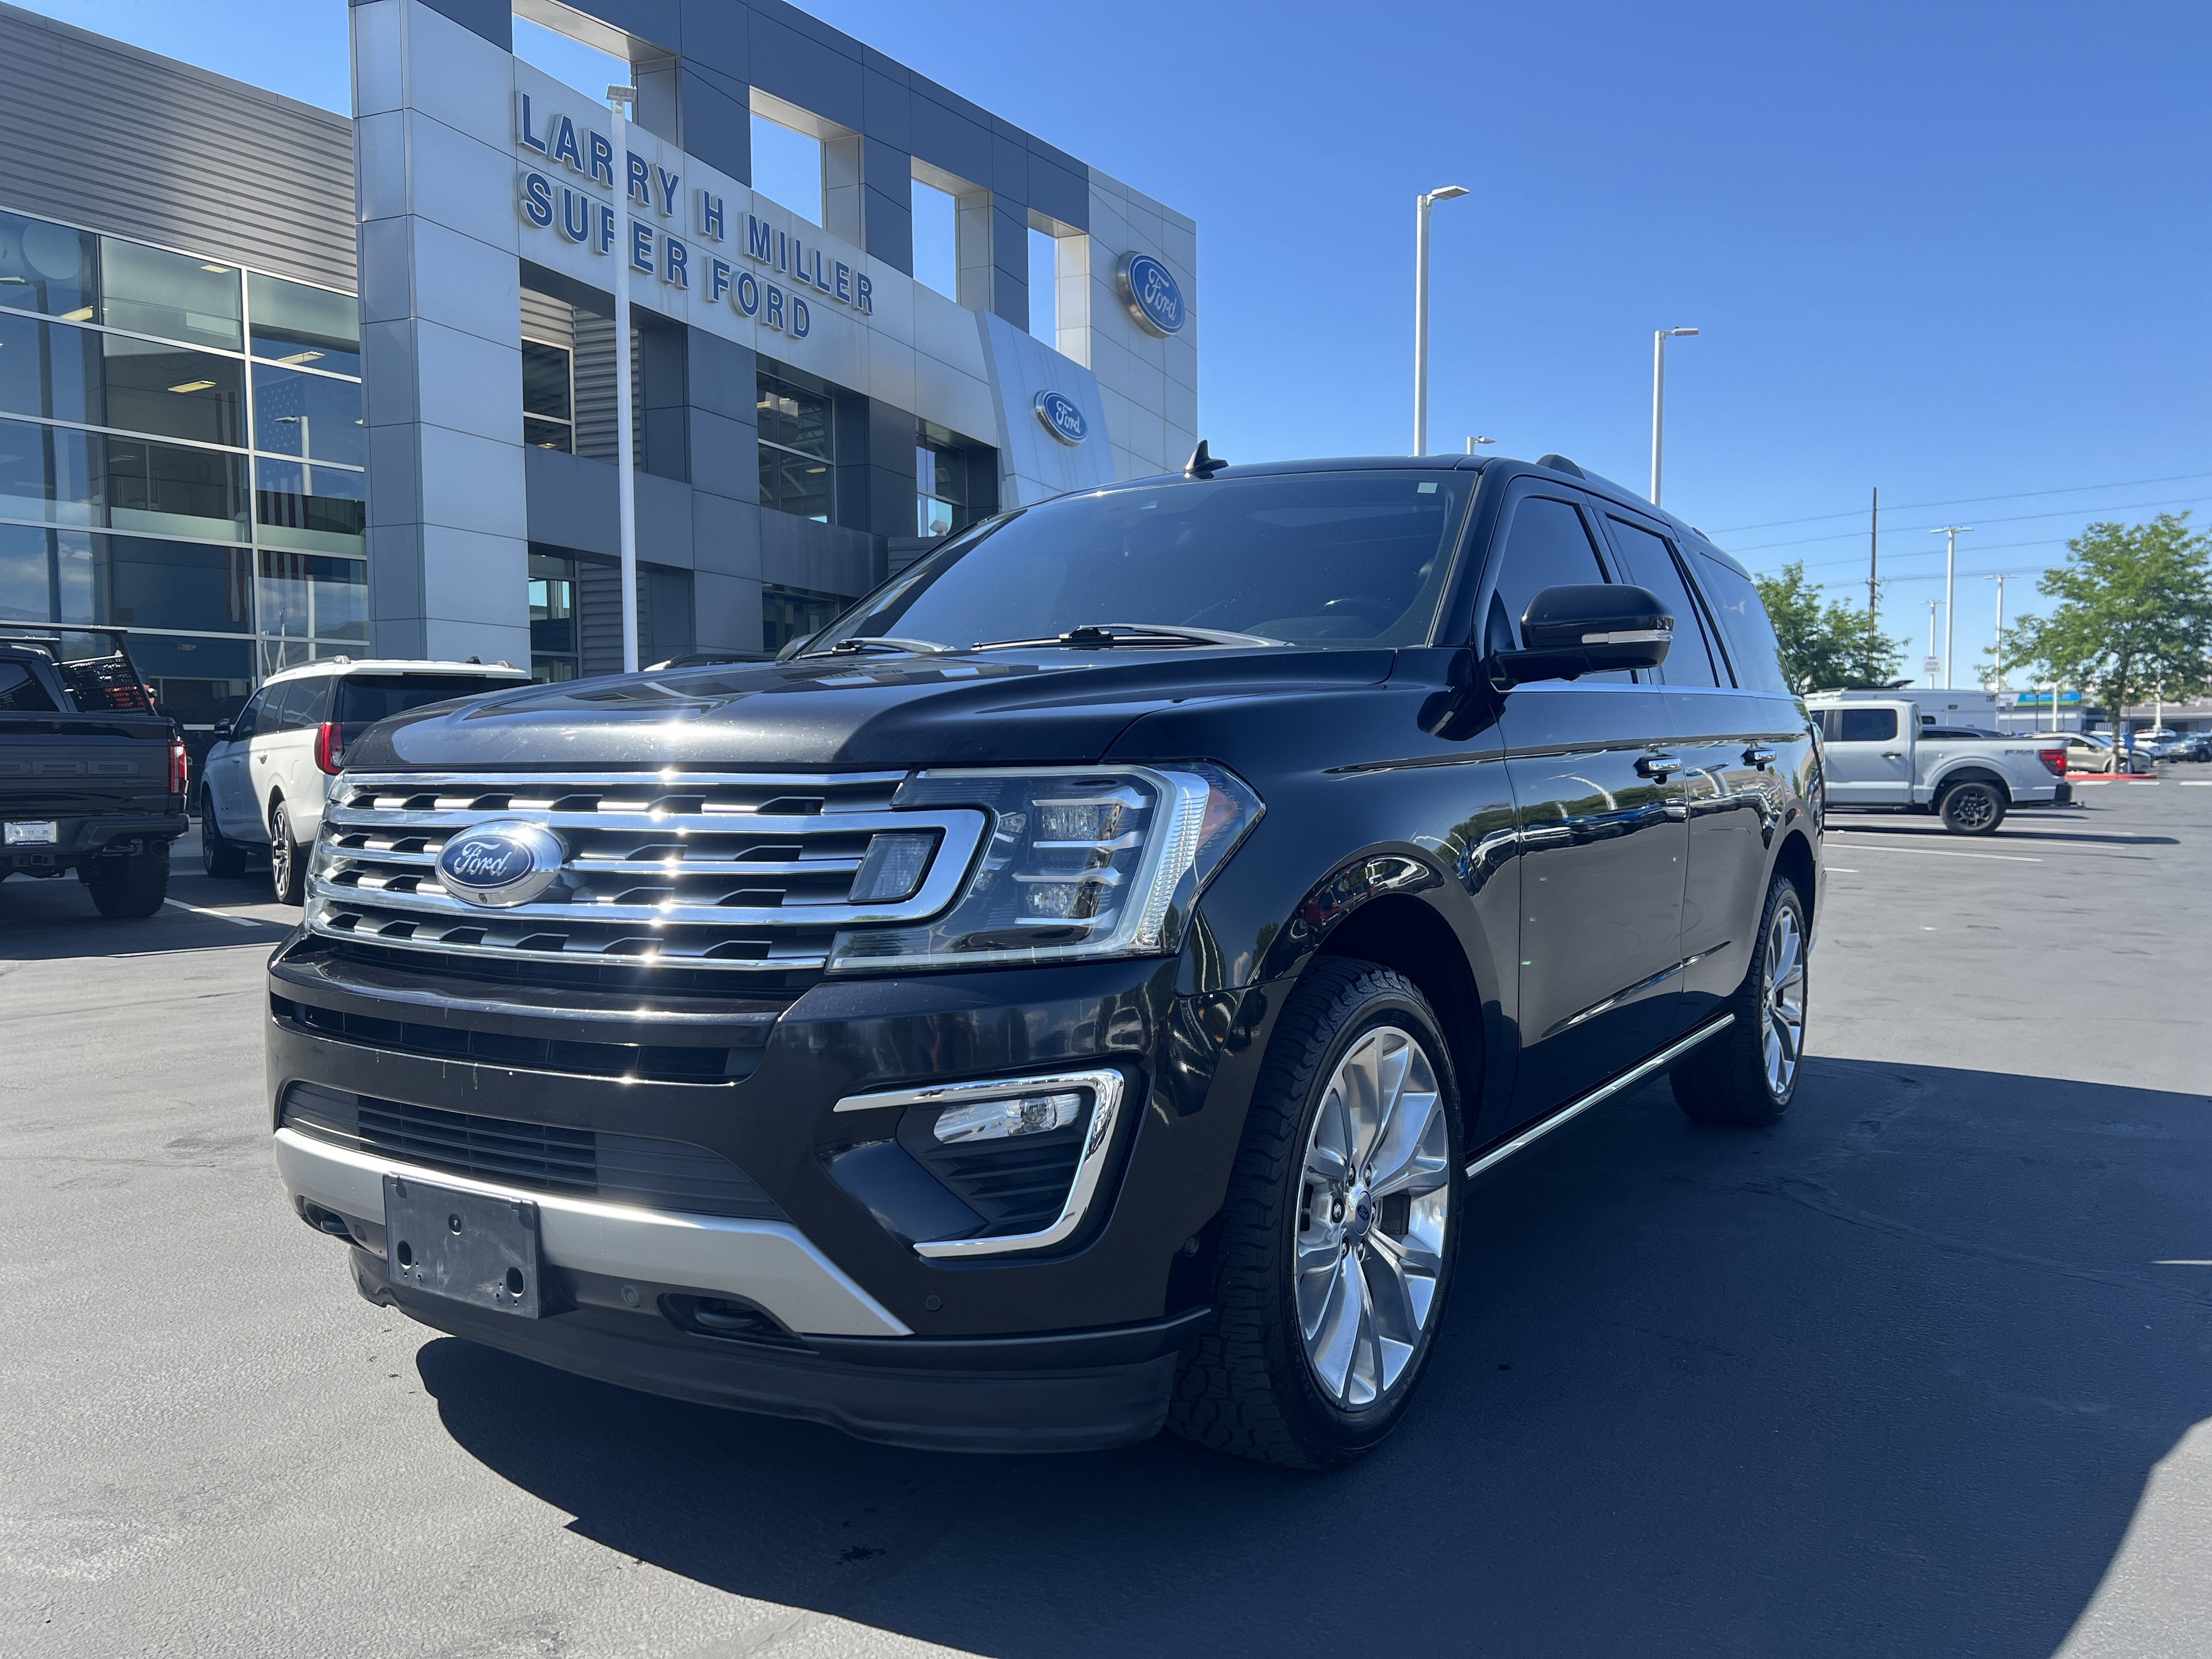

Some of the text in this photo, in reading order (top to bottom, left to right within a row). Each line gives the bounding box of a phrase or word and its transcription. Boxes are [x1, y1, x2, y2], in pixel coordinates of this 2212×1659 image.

[517, 91, 874, 315] LARRY H MILLER
[520, 171, 810, 340] SUPER FORD
[1144, 267, 1177, 321] Ford
[1056, 400, 1082, 434] Ford
[453, 842, 512, 877] Ford
